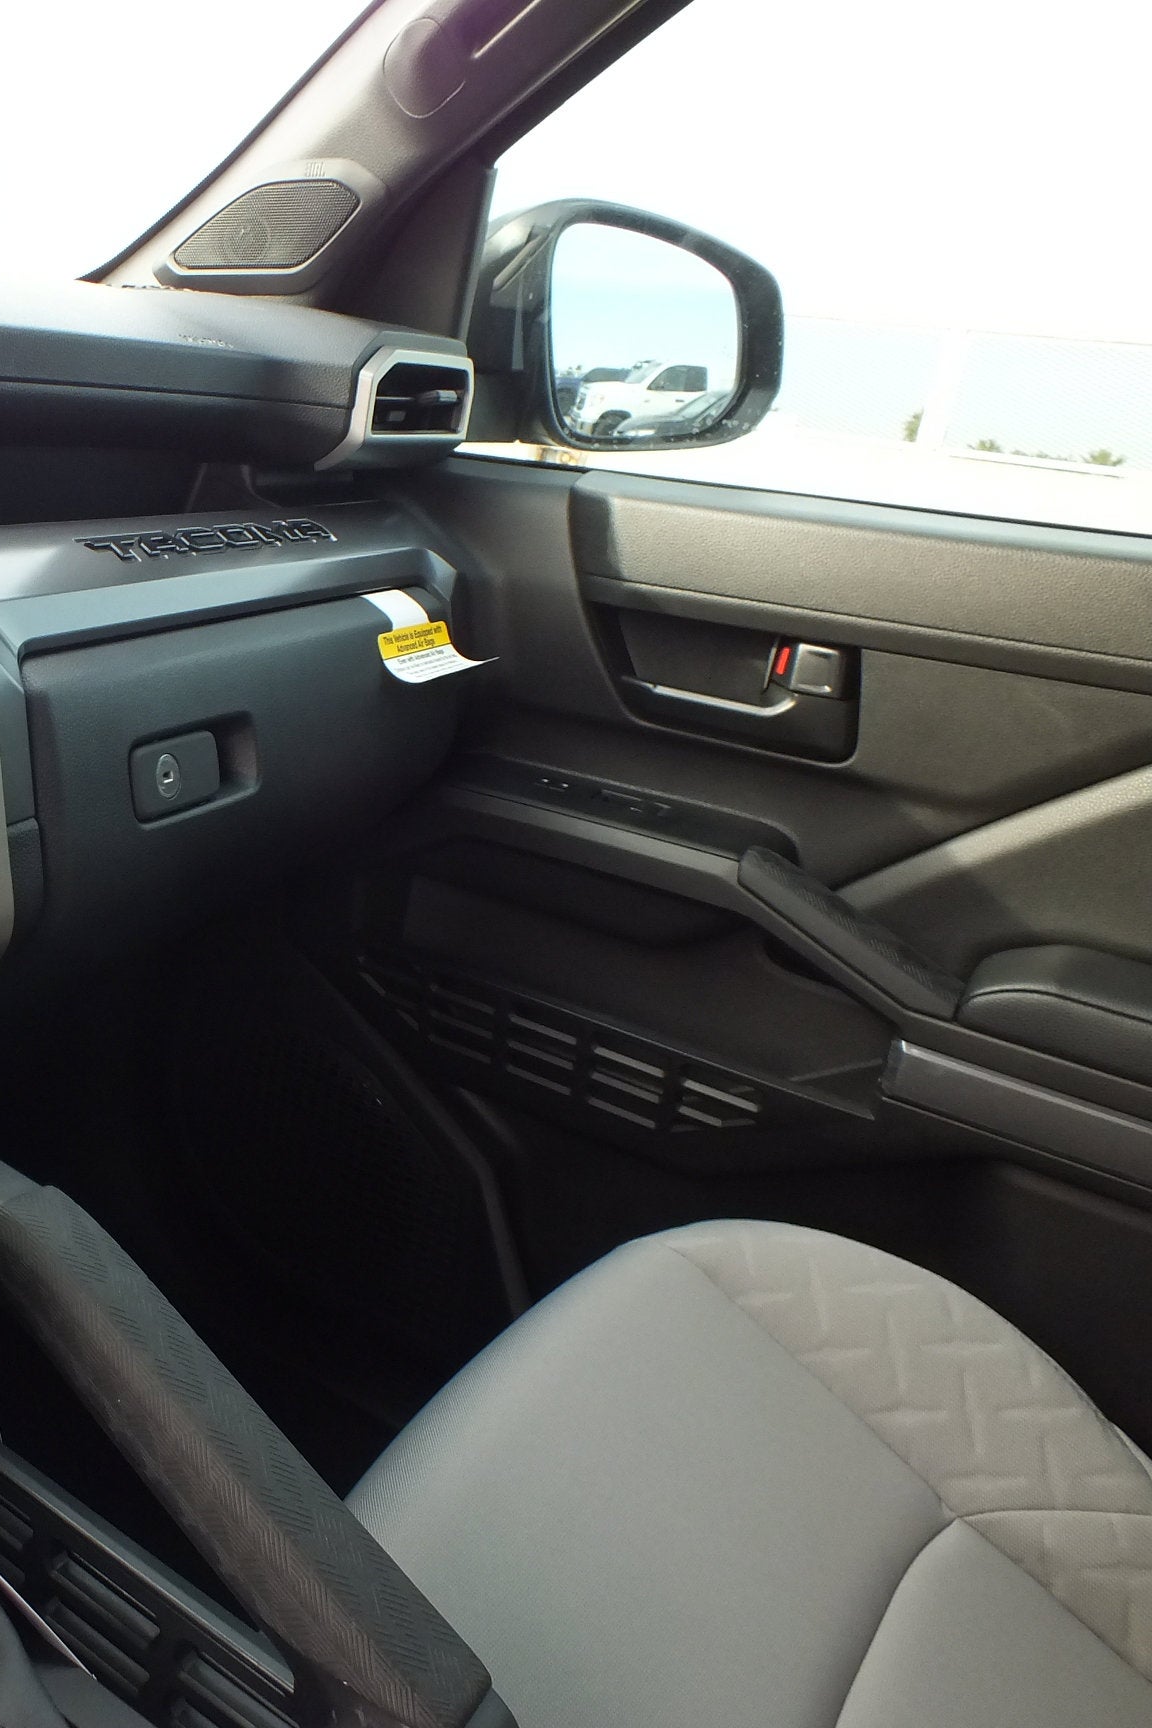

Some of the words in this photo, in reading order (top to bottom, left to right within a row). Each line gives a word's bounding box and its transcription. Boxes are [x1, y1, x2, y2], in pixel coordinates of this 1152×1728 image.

[72, 517, 338, 562] TACOMA
[383, 636, 393, 645] This
[394, 633, 409, 642] Vehicle
[414, 628, 433, 638] Equipped
[434, 625, 442, 633] with
[397, 641, 417, 652] Advanced
